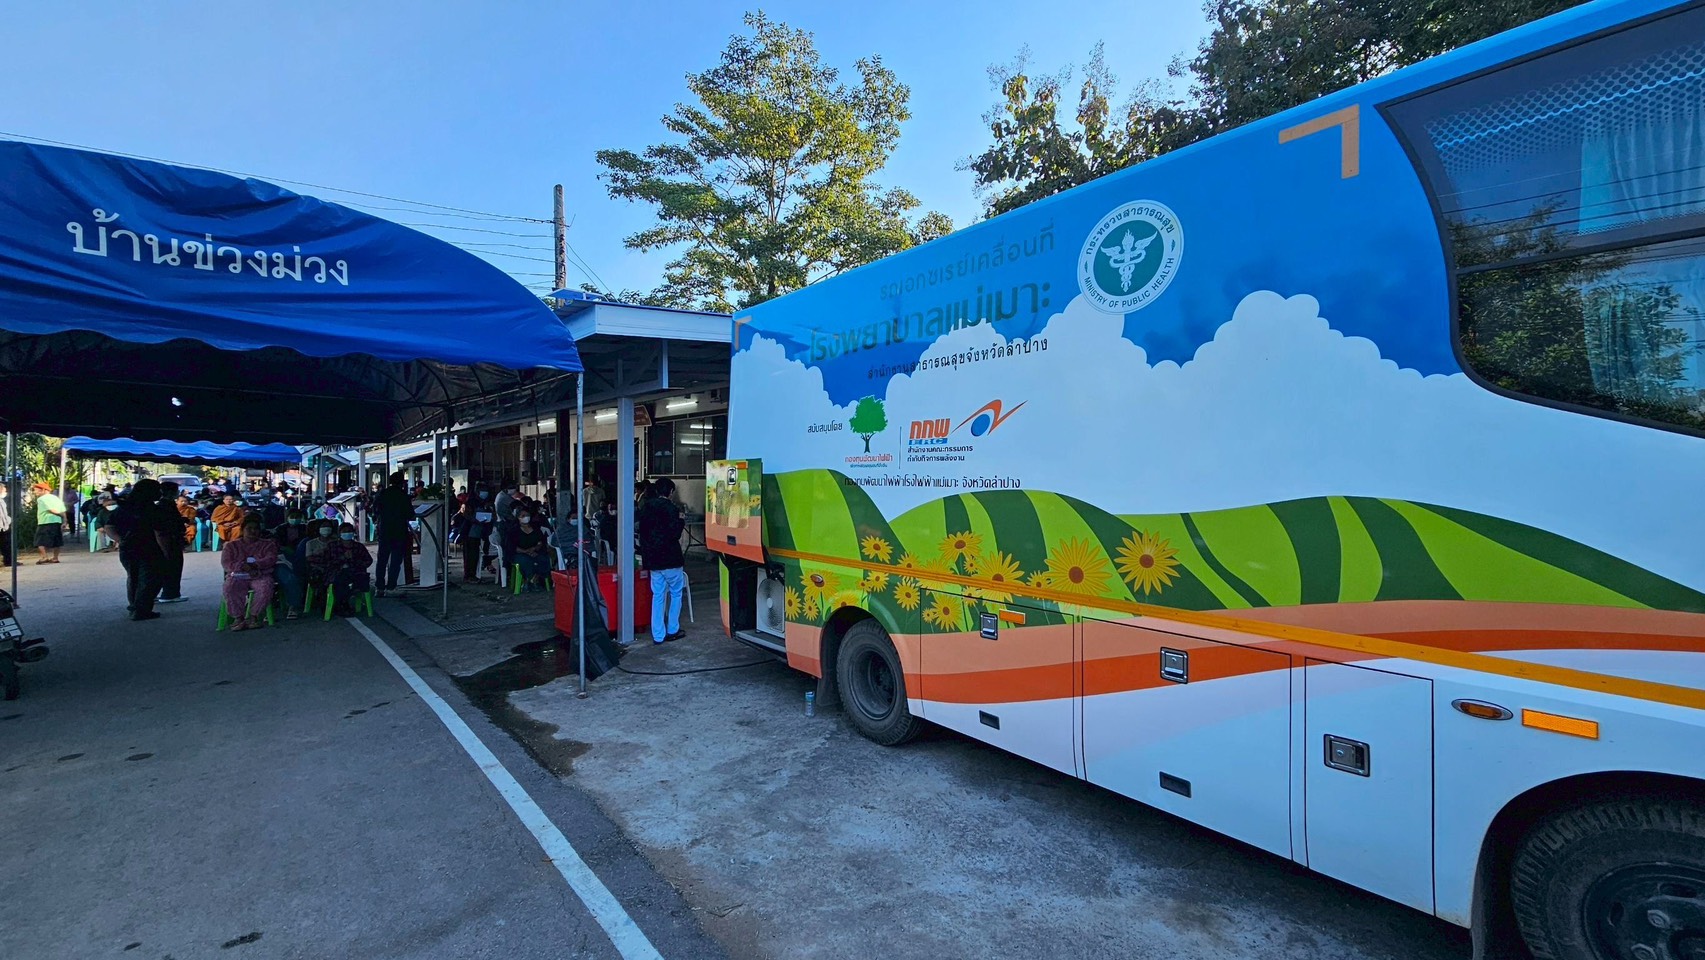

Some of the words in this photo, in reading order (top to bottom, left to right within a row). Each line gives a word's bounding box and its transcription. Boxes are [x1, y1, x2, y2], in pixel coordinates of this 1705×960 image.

[66, 208, 350, 287] บ้านข่วงม่วง
[1086, 206, 1175, 255] กระทรวงสาธารณสุข
[1084, 276, 1107, 304] MINISTRY
[1108, 300, 1119, 308] OF
[1121, 290, 1151, 308] PUBLIC
[1151, 257, 1175, 291] HEALTH
[810, 281, 1052, 363] โรงพยาบาลแม่เมาะ
[909, 418, 951, 439] กกพ
[962, 475, 1021, 489] จังหวัดลำปาง
